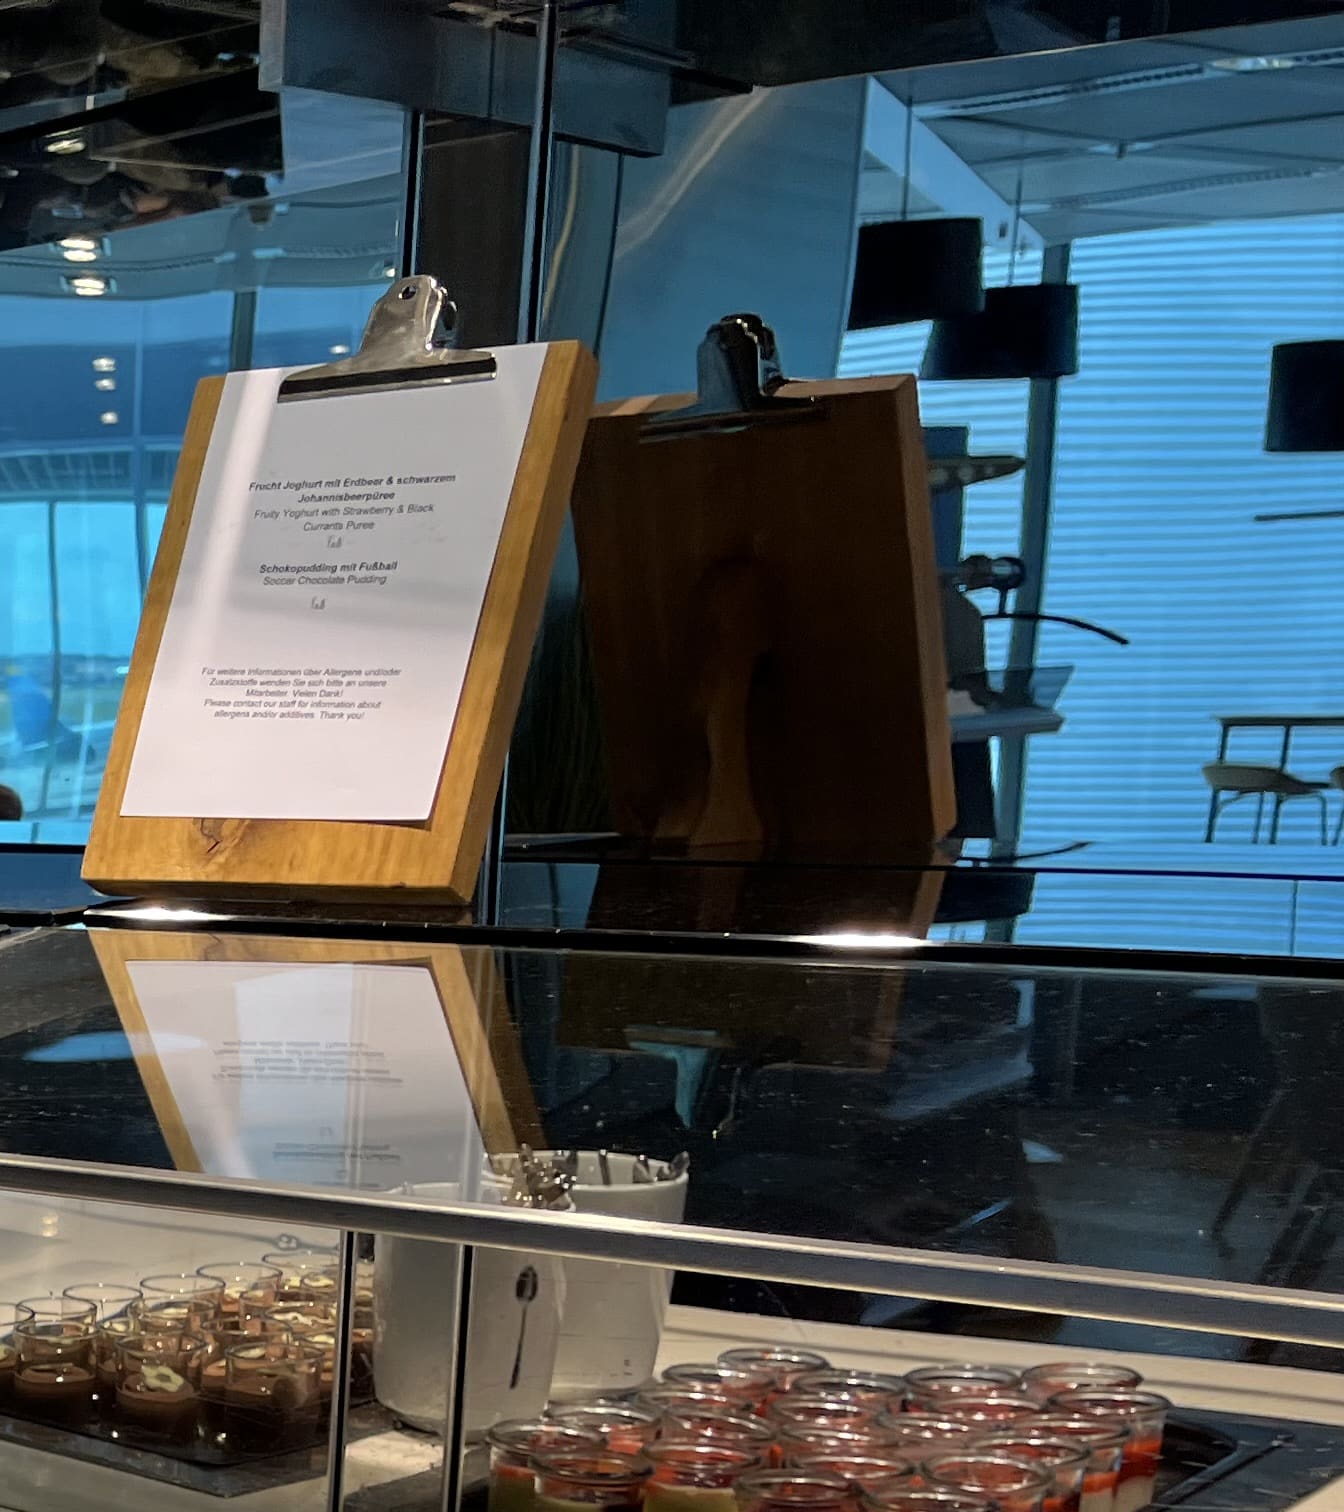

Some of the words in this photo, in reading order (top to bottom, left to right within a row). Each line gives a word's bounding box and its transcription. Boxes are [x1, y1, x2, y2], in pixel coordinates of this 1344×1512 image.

[249, 481, 281, 491] Frucht
[283, 479, 323, 491] Joghurt
[324, 478, 342, 488] mit
[343, 477, 384, 487] Erdbeer
[386, 476, 393, 485] &
[396, 475, 456, 484] schwarzem
[298, 492, 395, 503] Johannisbeerpüree
[283, 508, 319, 519] Yoghurt
[321, 508, 340, 516] with
[343, 506, 394, 515] Strawberry
[397, 504, 404, 513] &
[407, 504, 434, 513] Black
[303, 521, 343, 531] Currants
[259, 563, 337, 574] Schokopudding
[340, 563, 357, 572] mit
[359, 560, 398, 571] Fußball
[263, 576, 296, 585] Soccer
[298, 575, 345, 585] Chocolate
[347, 575, 387, 585] Pudding
[292, 678, 306, 686] Sie
[278, 700, 296, 708] staff
[297, 700, 309, 708] for
[310, 700, 356, 708] information
[320, 711, 345, 719] Thank
